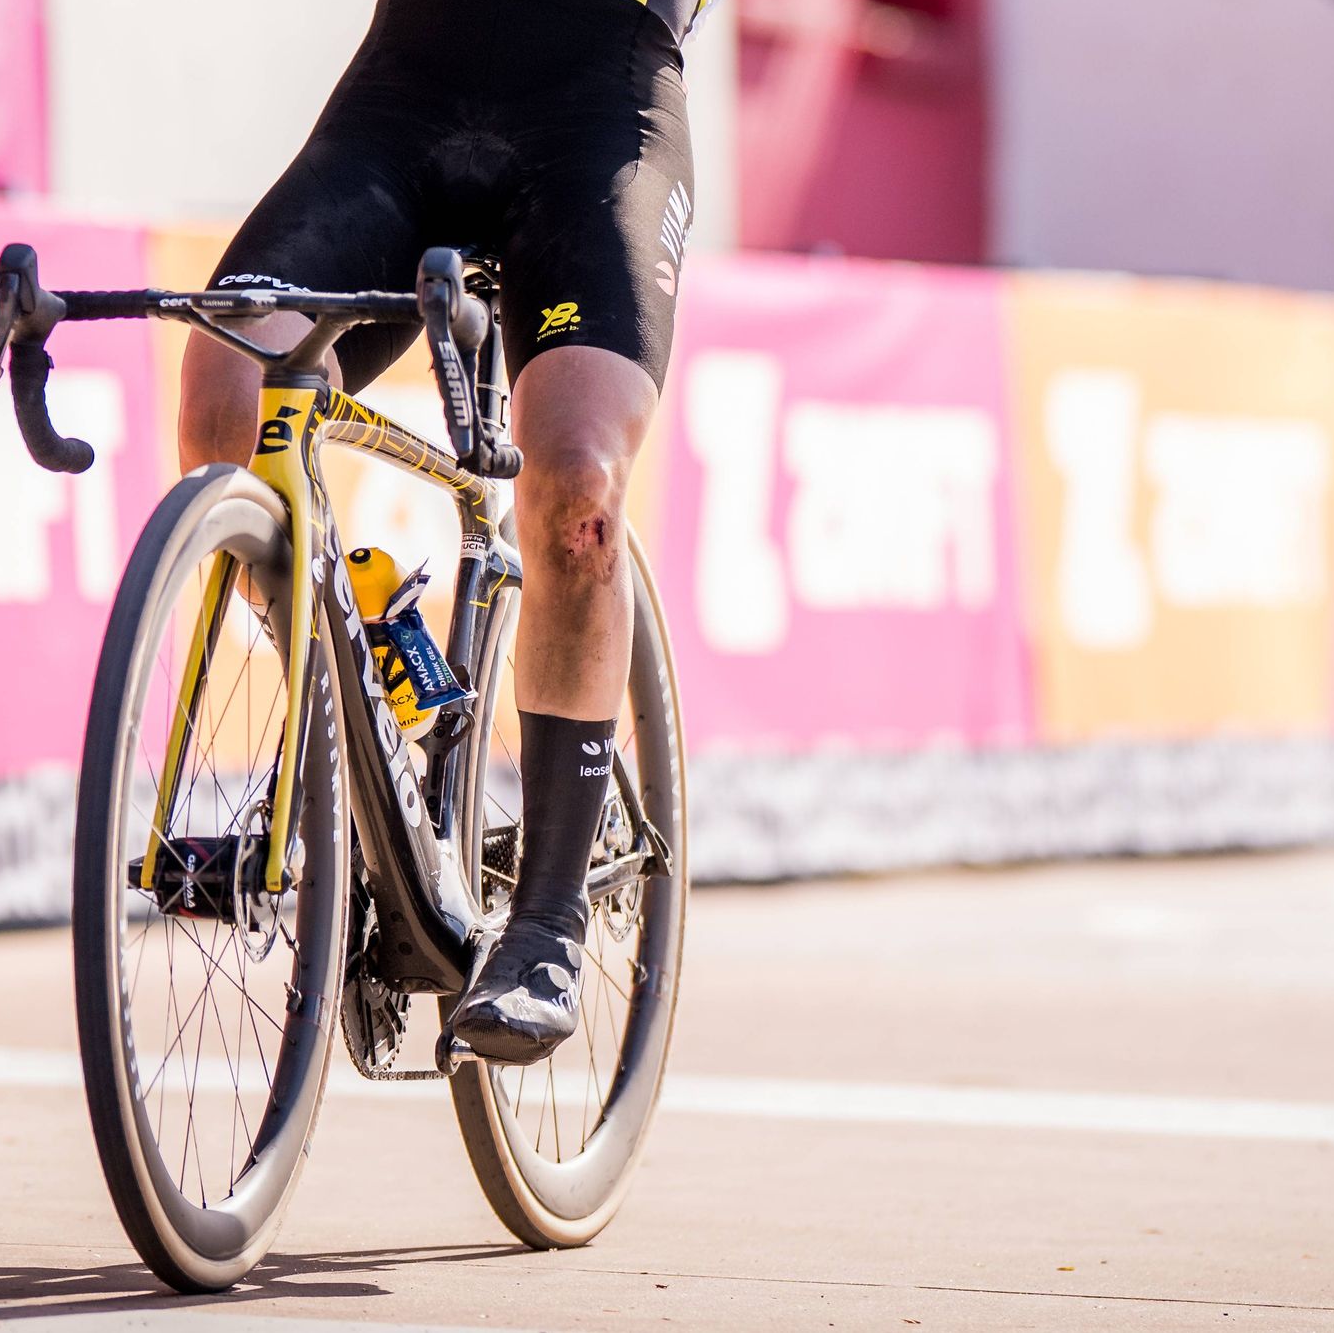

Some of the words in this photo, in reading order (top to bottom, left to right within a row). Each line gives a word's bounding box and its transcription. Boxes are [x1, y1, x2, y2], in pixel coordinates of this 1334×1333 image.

[218, 273, 313, 294] cerv
[201, 299, 234, 307] GARMIN
[537, 327, 567, 343] yellow
[438, 341, 469, 427] SRAM
[462, 542, 478, 550] UCI
[426, 645, 436, 659] GEL
[406, 646, 435, 691] AMACX
[432, 662, 447, 687] DRINK
[438, 656, 452, 684] CITRUS
[388, 691, 414, 707] ACX
[320, 670, 342, 843] RESERVE
[580, 765, 610, 777] lease
[183, 854, 196, 908] GRVAA
